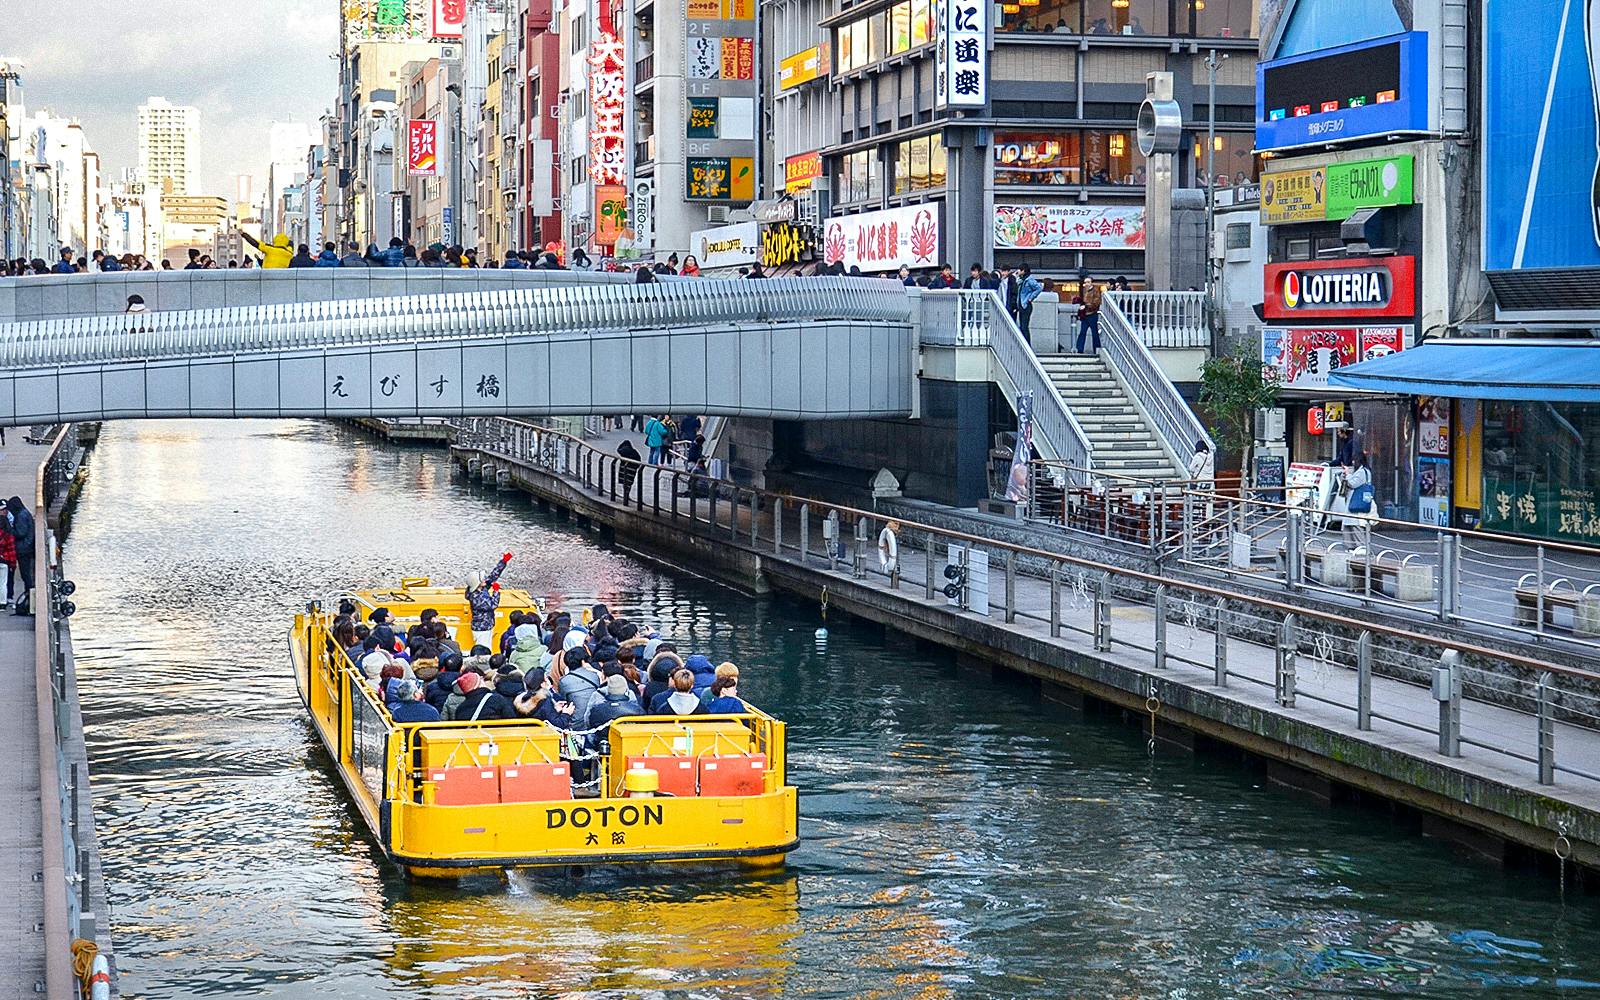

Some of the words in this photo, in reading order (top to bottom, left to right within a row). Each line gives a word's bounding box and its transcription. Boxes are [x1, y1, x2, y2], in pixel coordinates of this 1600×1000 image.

[955, 0, 980, 95] に道楽
[588, 31, 624, 186] 大阪王将
[411, 128, 421, 162] ドラッグ
[421, 123, 434, 154] ツルハ
[692, 167, 726, 182] びっくり
[690, 182, 728, 197] ドンキー
[1030, 218, 1125, 238] かにしゃぶ会席
[1302, 272, 1382, 303] LOTTERIA
[332, 374, 500, 399] えびす橋
[546, 804, 664, 829] DOTON
[585, 831, 626, 846] 大阪
